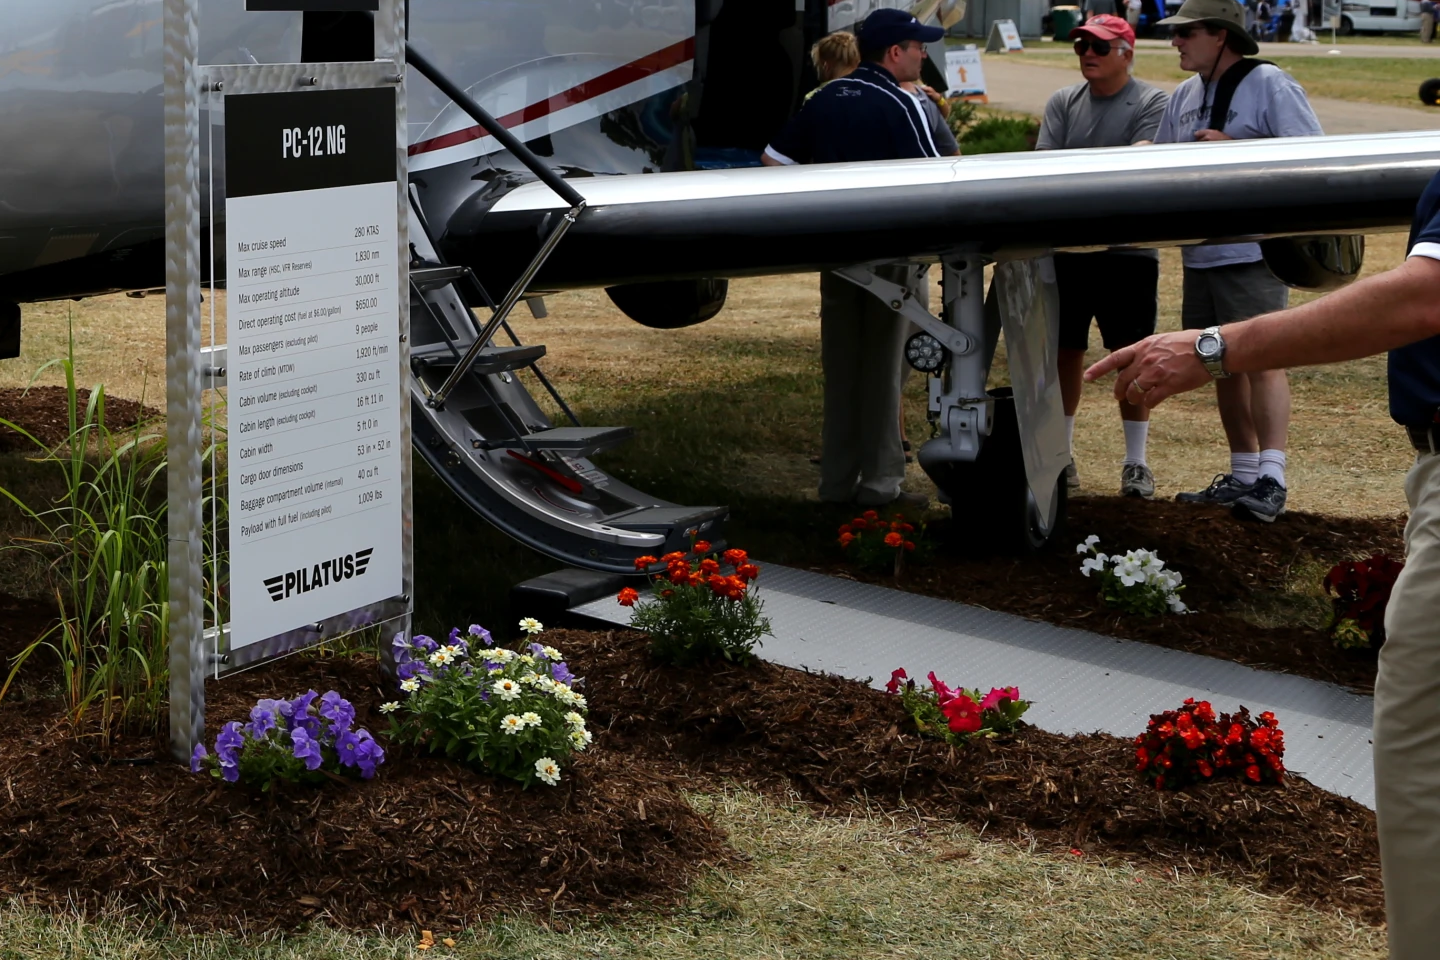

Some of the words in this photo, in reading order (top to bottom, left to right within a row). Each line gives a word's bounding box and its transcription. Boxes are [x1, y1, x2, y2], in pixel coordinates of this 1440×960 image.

[282, 126, 323, 159] PC-12
[326, 124, 346, 155] NG
[355, 227, 365, 237] 280
[367, 225, 379, 236] KTAS
[238, 242, 250, 252] Max
[252, 240, 268, 251] cruise
[270, 237, 286, 250] speed
[372, 251, 379, 259] nm
[239, 268, 250, 278] Max
[252, 266, 267, 278] range
[282, 263, 291, 272] VFR
[292, 261, 312, 270] Reserves)
[355, 274, 374, 286] 30,000
[375, 273, 379, 282] ft
[239, 294, 250, 304] Max
[252, 290, 278, 303] operating
[280, 286, 300, 298] altitude
[239, 319, 255, 330] Direct
[257, 314, 283, 328] operating
[285, 312, 296, 322] cost
[298, 311, 307, 321] (fuel
[356, 324, 359, 334] 9
[361, 322, 378, 336] people
[239, 346, 250, 356] Max
[252, 340, 283, 355] passengers
[285, 336, 306, 348] (excluding
[307, 334, 318, 345] pilot)
[240, 371, 252, 381] Rate
[254, 368, 260, 379] of
[261, 365, 276, 377] climb
[278, 364, 295, 375] (MTOW)
[356, 372, 367, 383] 330
[368, 372, 374, 380] cu
[376, 369, 380, 379] ft
[240, 396, 255, 407] Cabin
[257, 392, 277, 403] volume
[279, 388, 300, 400] (excluding
[301, 384, 317, 394] cockpit)
[357, 396, 363, 407] 16
[365, 396, 369, 405] ft
[371, 394, 376, 404] 11
[379, 393, 383, 402] in
[240, 421, 256, 433] Cabin
[258, 416, 275, 430] length
[277, 414, 298, 426] (excluding
[299, 410, 315, 420] cockpit)
[357, 421, 361, 431] 5
[362, 420, 366, 430] ft
[368, 419, 371, 429] 0
[373, 418, 378, 427] in
[240, 446, 256, 459] Cabin
[258, 442, 273, 454] width
[358, 445, 364, 456] 53
[366, 444, 371, 454] in
[378, 440, 384, 450] 52
[386, 439, 391, 448] in
[240, 473, 257, 485] Cargo
[259, 470, 271, 480] door
[273, 462, 303, 477] dimensions
[358, 469, 365, 479] 40
[367, 469, 372, 478] cu
[374, 466, 378, 475] ft
[241, 496, 265, 511] Baggage
[267, 486, 303, 503] compartment
[304, 482, 323, 494] volume
[325, 477, 343, 490] (internal)
[241, 521, 263, 537] Payload
[265, 517, 276, 530] with
[278, 514, 286, 526] full
[288, 512, 298, 523] fuel
[300, 508, 320, 522] (including
[321, 505, 332, 515] pilot)
[285, 553, 355, 599] PILATUS
